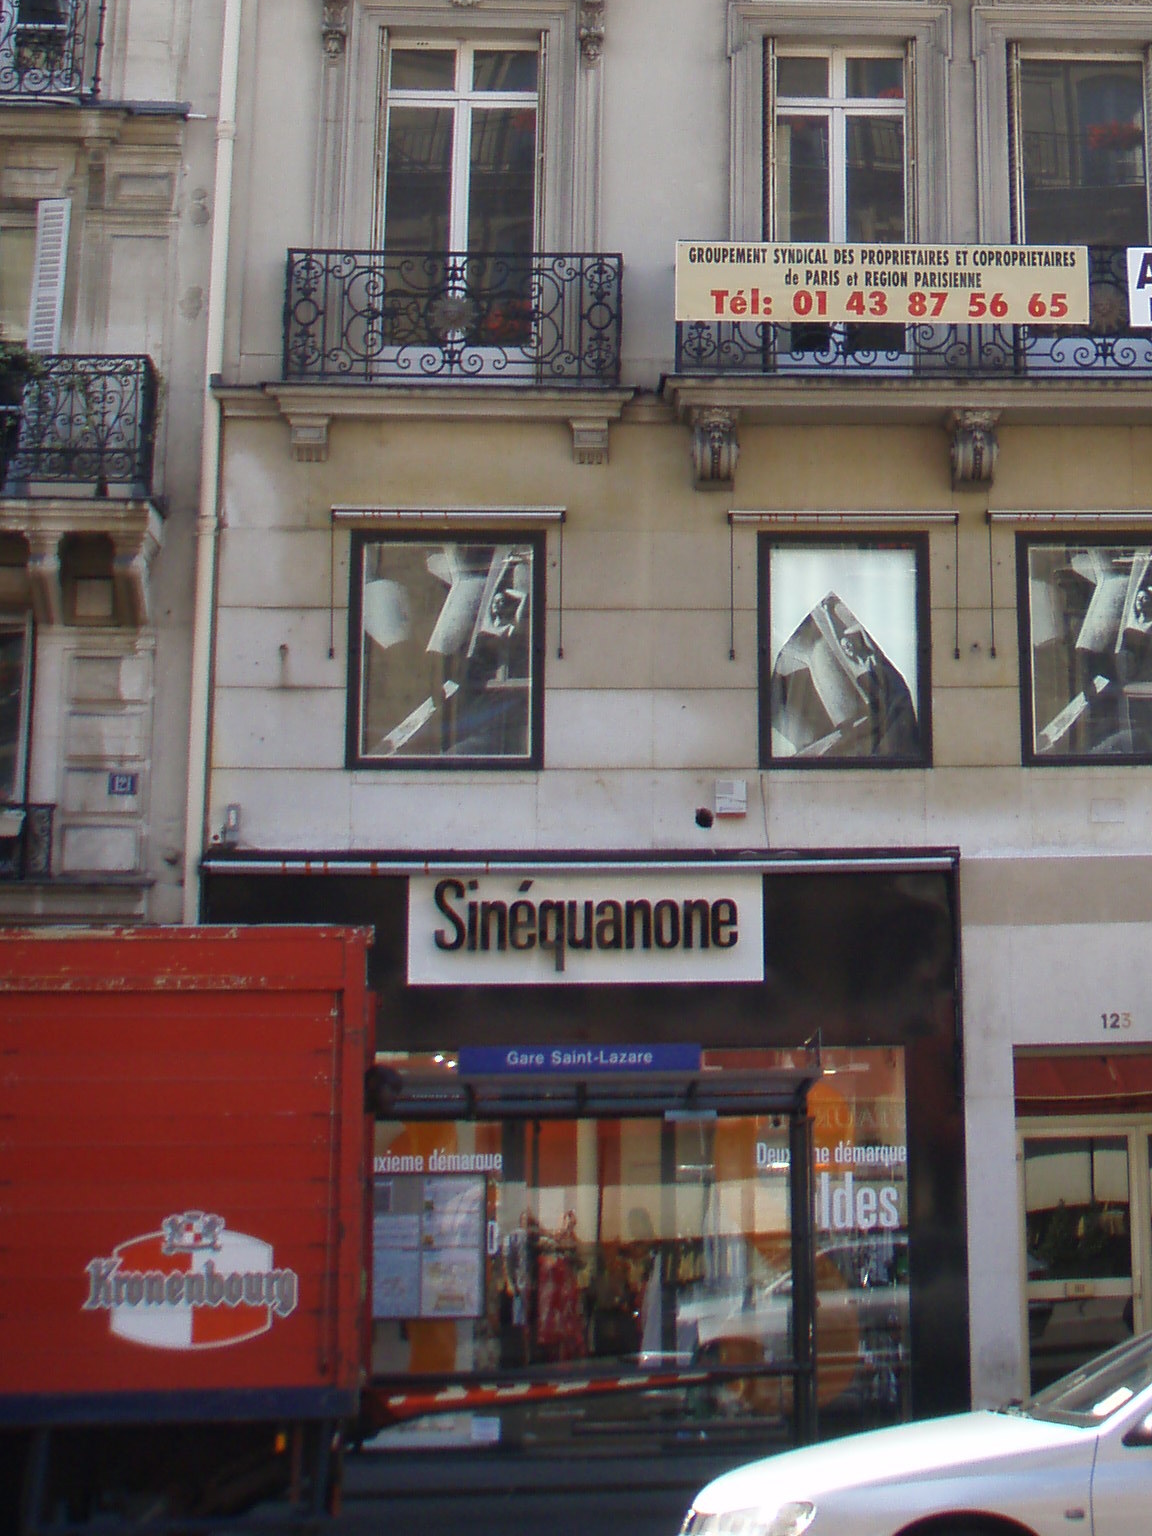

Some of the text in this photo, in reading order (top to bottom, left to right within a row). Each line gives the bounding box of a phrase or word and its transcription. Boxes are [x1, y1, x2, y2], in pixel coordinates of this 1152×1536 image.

[688, 247, 1076, 267] GROUPEMENT SYNDICAL DES PROPRIETAIRES ET COPROPRIETAIRES
[784, 268, 982, 288] de PARIS et REGION PARISIENNE
[710, 288, 1069, 318] Tél: 01 43 87 56 65
[434, 878, 739, 972] Sinéquanone
[506, 1049, 653, 1065] Gare Saint-Lazare
[834, 1139, 907, 1168] démarque
[81, 1258, 298, 1318] Kronenbourg
